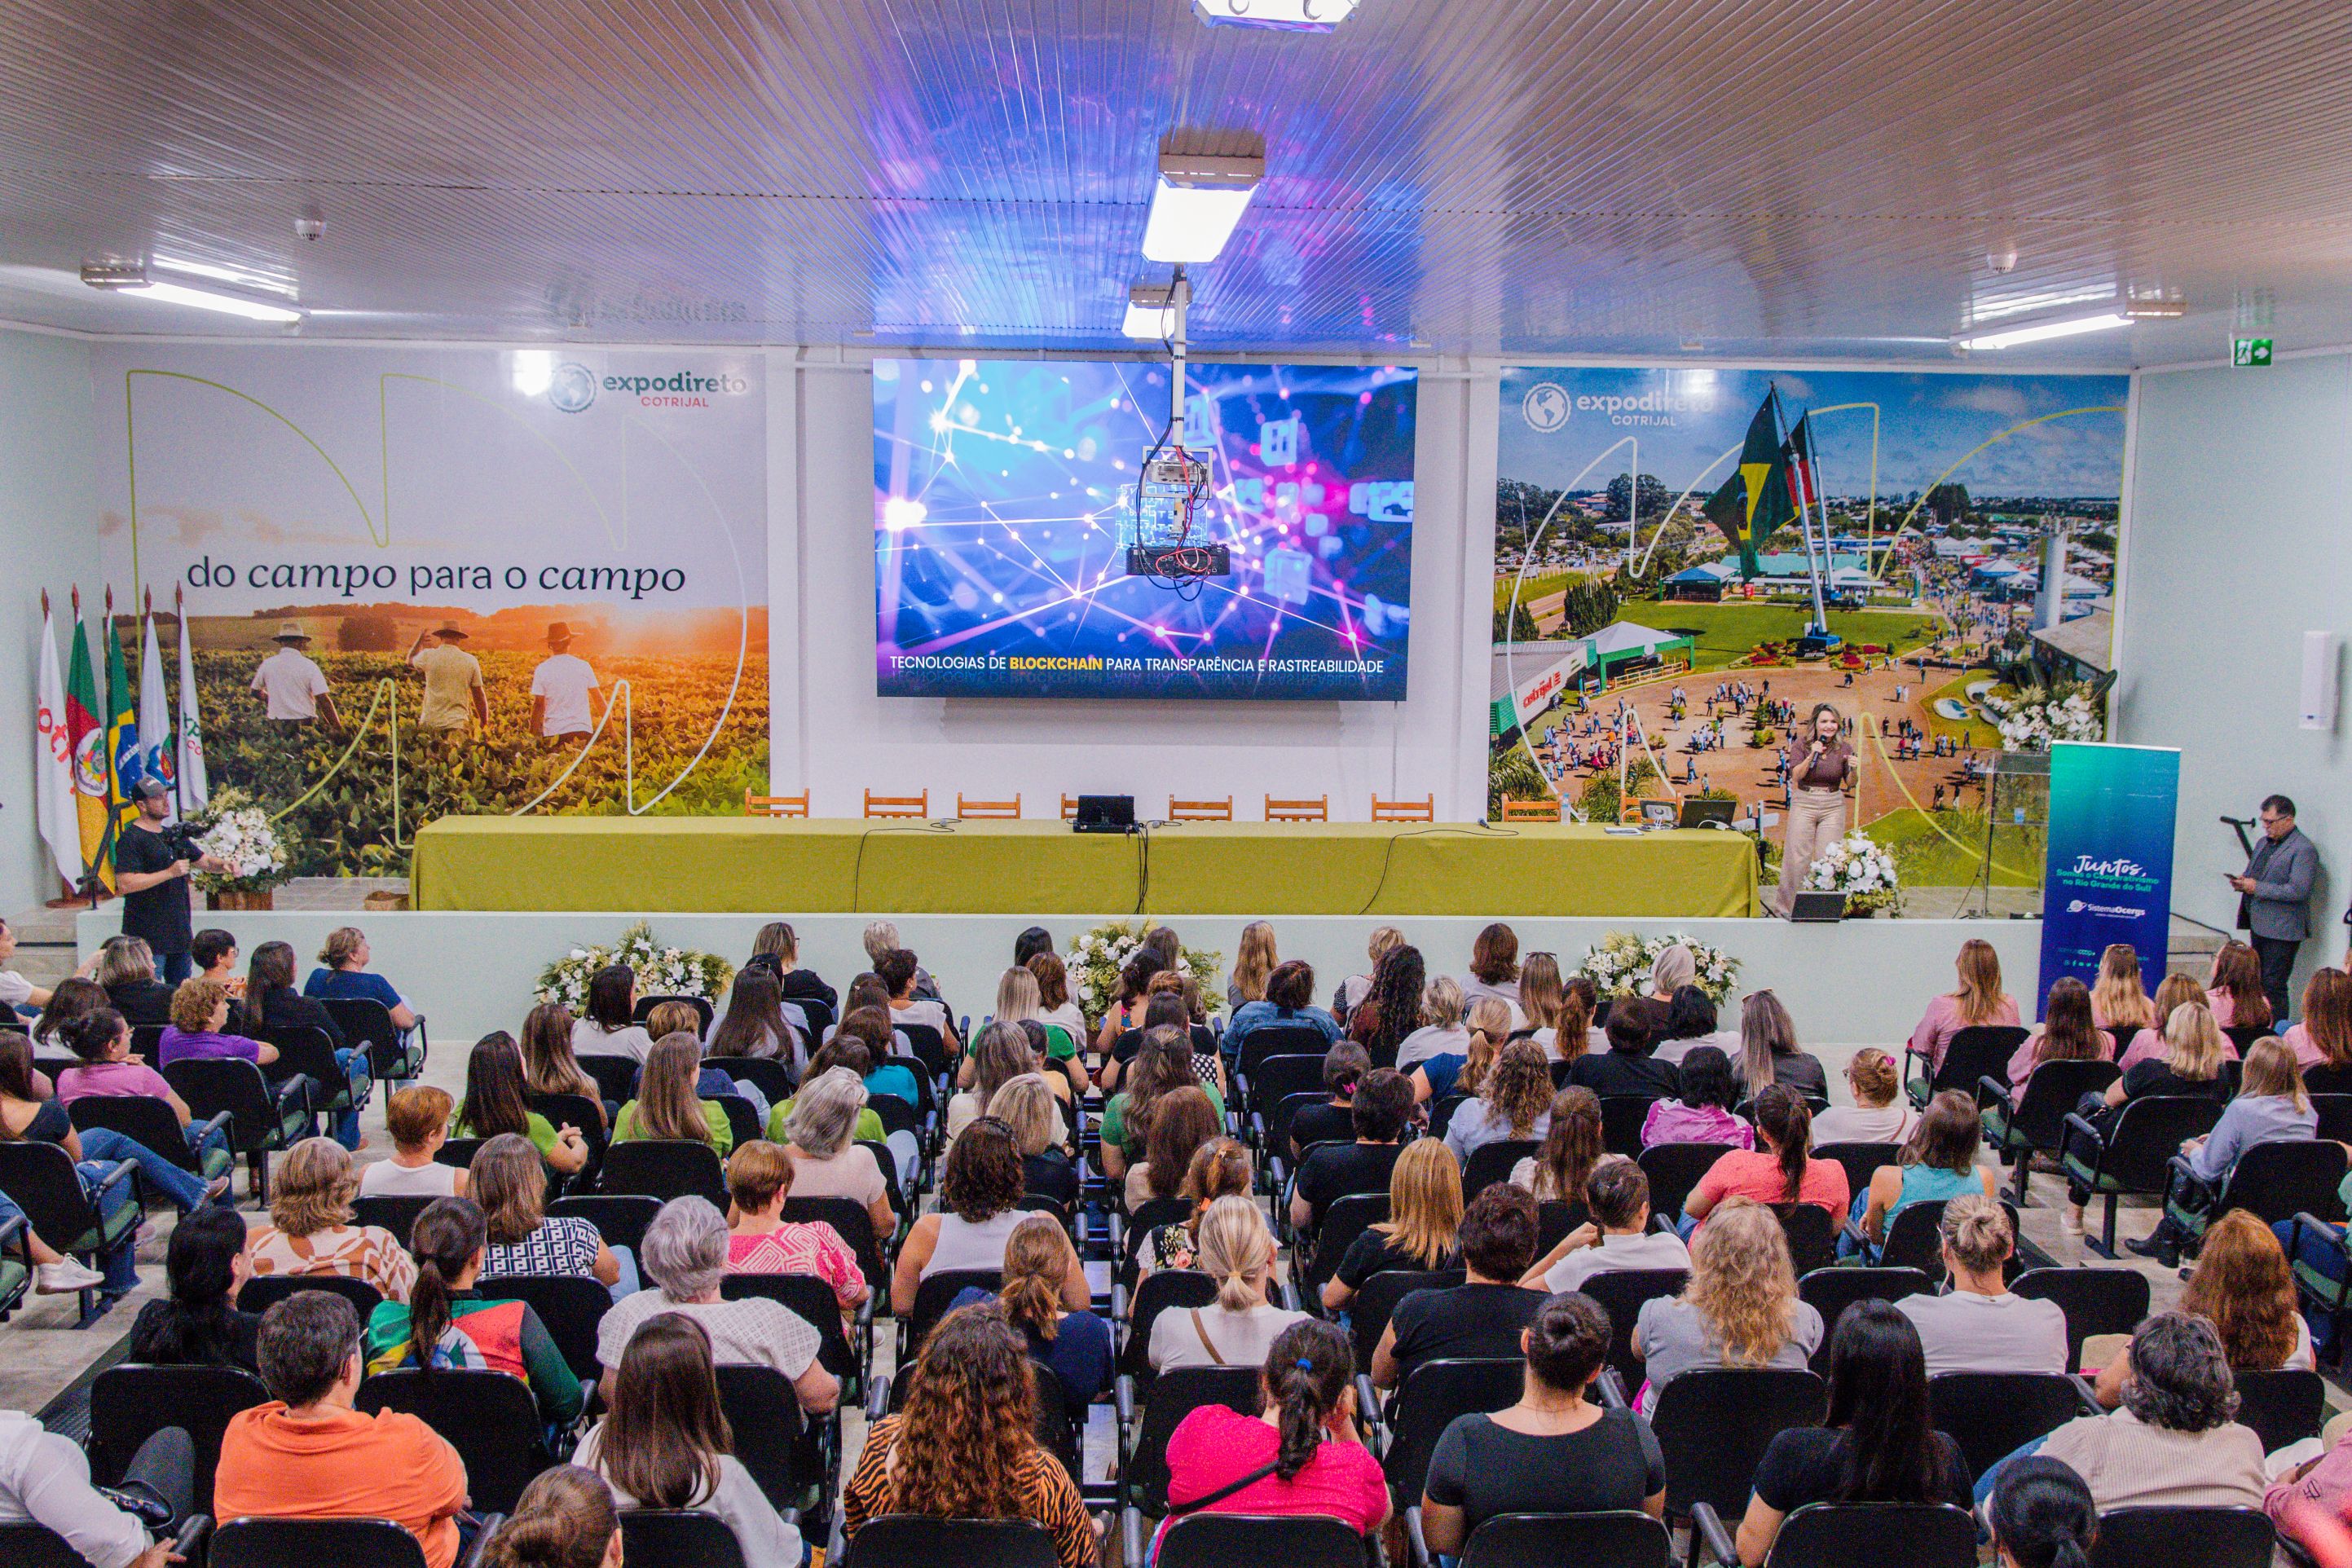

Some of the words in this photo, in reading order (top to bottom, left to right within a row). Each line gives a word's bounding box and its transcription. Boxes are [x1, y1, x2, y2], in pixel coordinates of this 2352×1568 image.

[603, 371, 747, 395] expodireto
[641, 396, 709, 407] COTRIJAL
[1612, 415, 1676, 427] COTRIJAL
[187, 556, 236, 588] do
[248, 564, 397, 598] campo
[411, 565, 492, 596] para
[504, 566, 527, 591] o
[539, 565, 686, 601] campo
[890, 656, 985, 669] TECNOLOGIAS
[989, 657, 1006, 670] DE
[1010, 657, 1103, 671] BLOCKCHAIN
[1107, 658, 1141, 671] PARA
[1145, 656, 1255, 672] TRANSPARÊNCIA
[1258, 659, 1265, 672] E
[1269, 659, 1384, 673] RASTREABILIDADE
[2075, 879, 2089, 887] Rio
[2090, 880, 2120, 890] Grande
